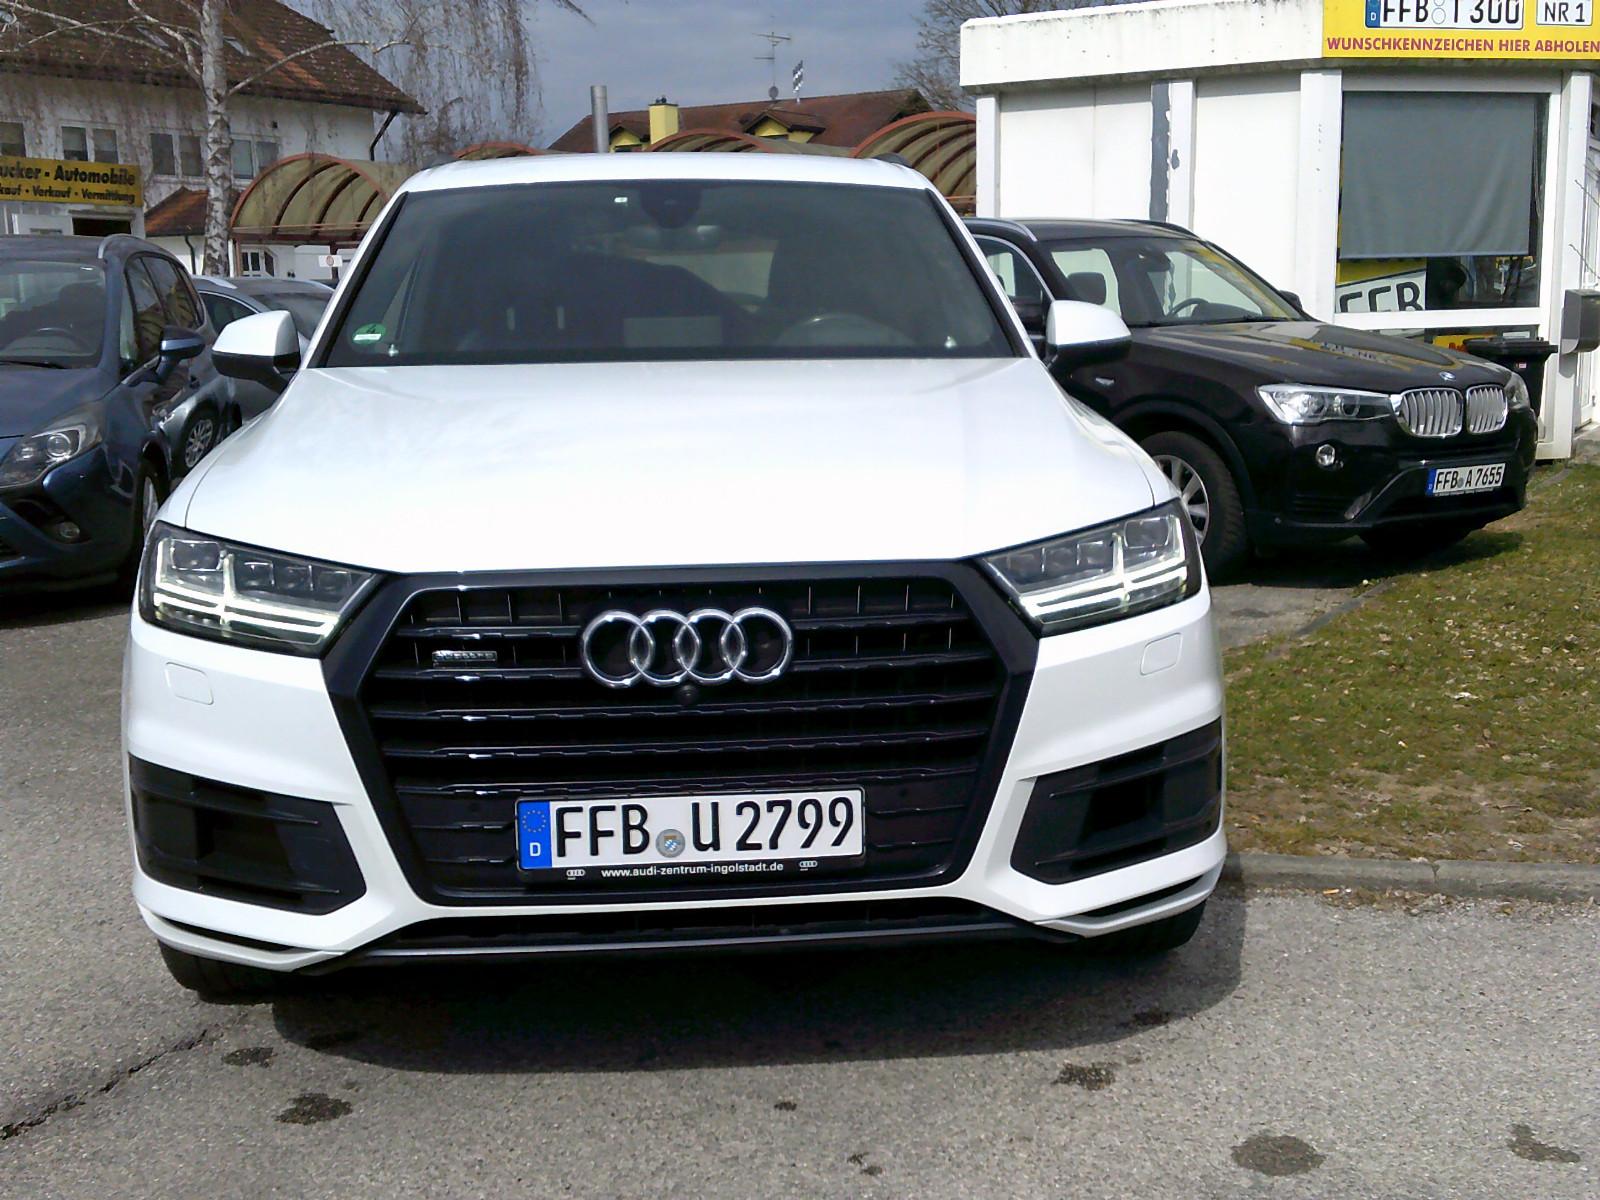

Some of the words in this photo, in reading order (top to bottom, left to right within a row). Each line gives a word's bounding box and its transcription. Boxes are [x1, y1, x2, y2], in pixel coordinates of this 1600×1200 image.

[1383, 0, 1428, 22] FFB
[1470, 0, 1520, 24] 300
[1544, 2, 1569, 22] NR
[1575, 3, 1585, 22] 1
[1327, 37, 1494, 51] WUNSCHKENNZEICHEN
[1499, 39, 1530, 52] HIER
[1535, 40, 1600, 53] ABHOLEN
[54, 165, 135, 186] Automobile
[32, 184, 73, 198] Verkauf
[1435, 471, 1459, 490] FFB
[1465, 469, 1473, 488] A
[1474, 466, 1503, 487] 7655
[529, 841, 541, 857] D
[555, 803, 650, 858] FFB
[691, 801, 721, 852] U
[735, 796, 855, 851] 2799
[601, 862, 784, 879] www.audi-zentrum-ingolstadt.de
